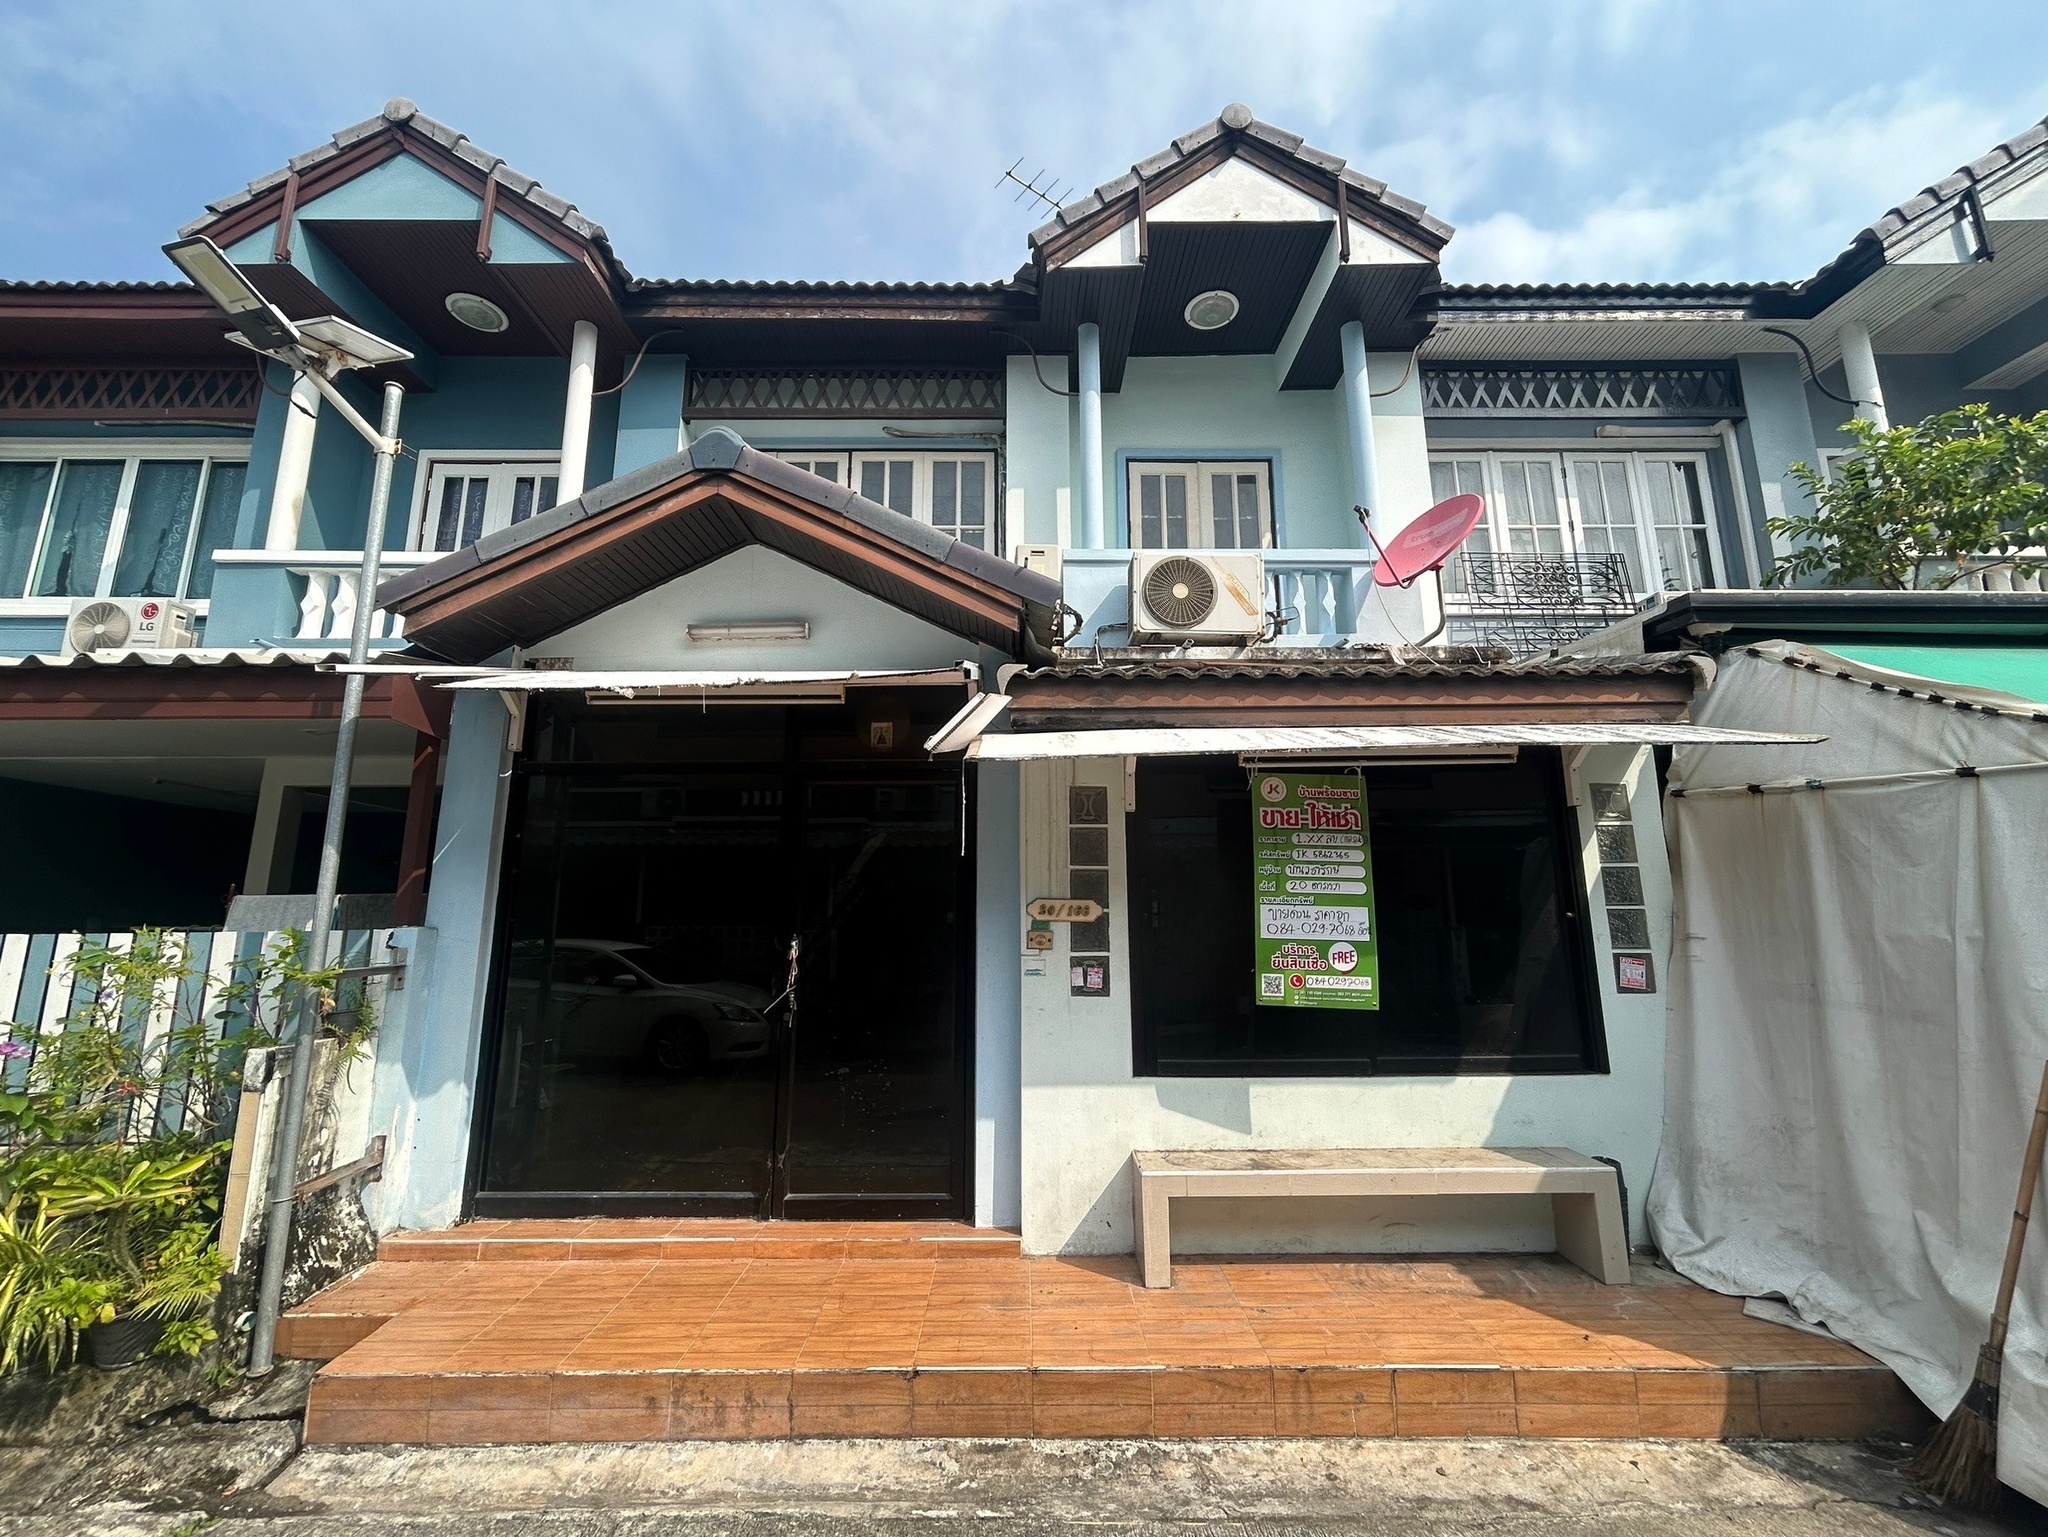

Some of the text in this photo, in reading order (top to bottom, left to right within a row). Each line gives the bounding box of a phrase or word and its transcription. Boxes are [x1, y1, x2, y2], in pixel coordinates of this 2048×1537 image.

[139, 622, 154, 631] LG
[1267, 784, 1280, 795] JK
[1299, 786, 1359, 798] บ้านพร้อมขาย
[1296, 849, 1309, 859] JK
[1259, 865, 1281, 875] หมู่บ้าน
[1290, 881, 1308, 891] 20
[1267, 905, 1311, 921] ขายด่วน
[1283, 944, 1316, 954] บริการ
[1272, 953, 1328, 970] ยื่นสินเชื่อ
[1332, 950, 1356, 965] FREE
